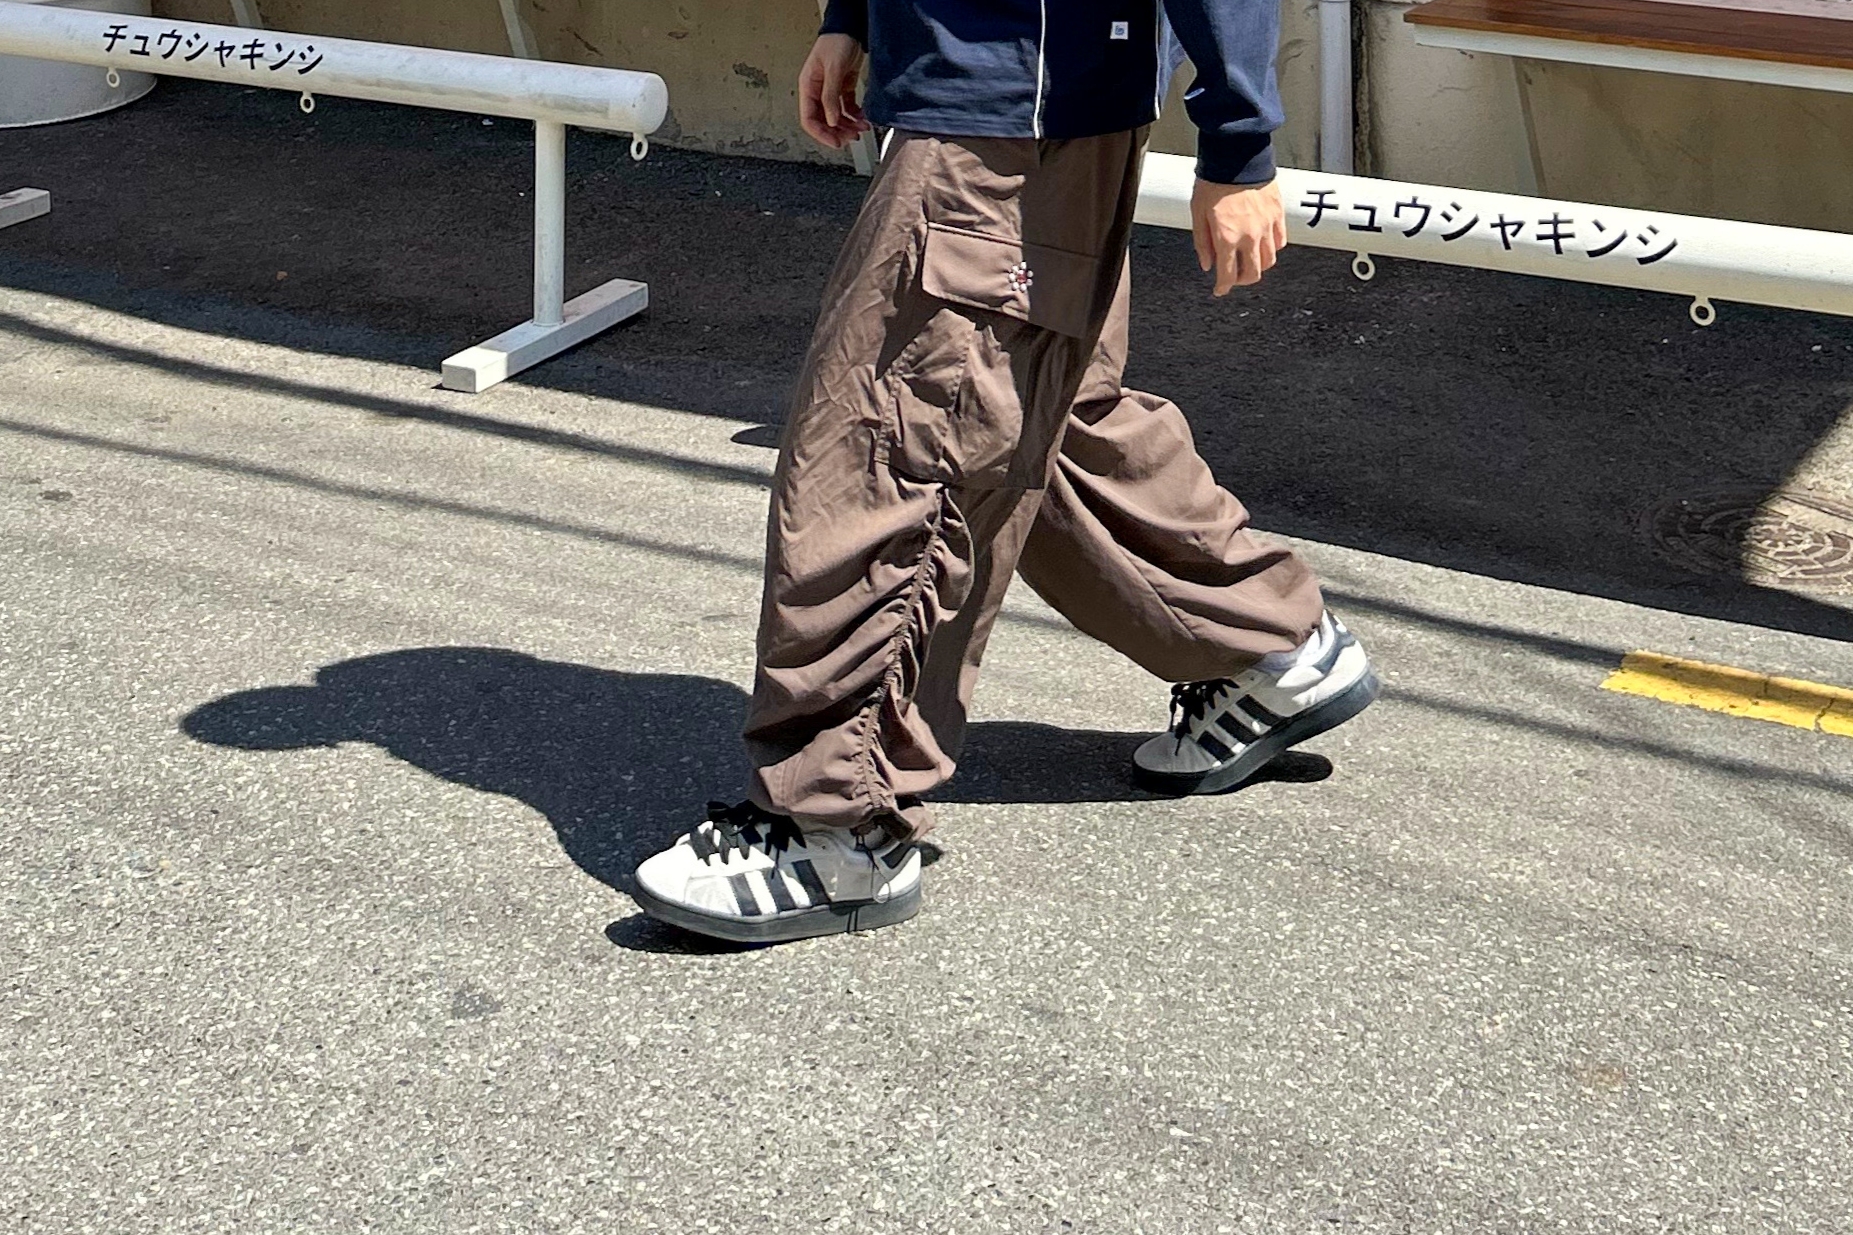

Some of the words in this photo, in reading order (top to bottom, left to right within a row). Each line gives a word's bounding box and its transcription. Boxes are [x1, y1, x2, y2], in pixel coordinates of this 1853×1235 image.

[103, 24, 323, 75] チュウシャキンシ
[1300, 188, 1679, 266] チュウシャキンシ
